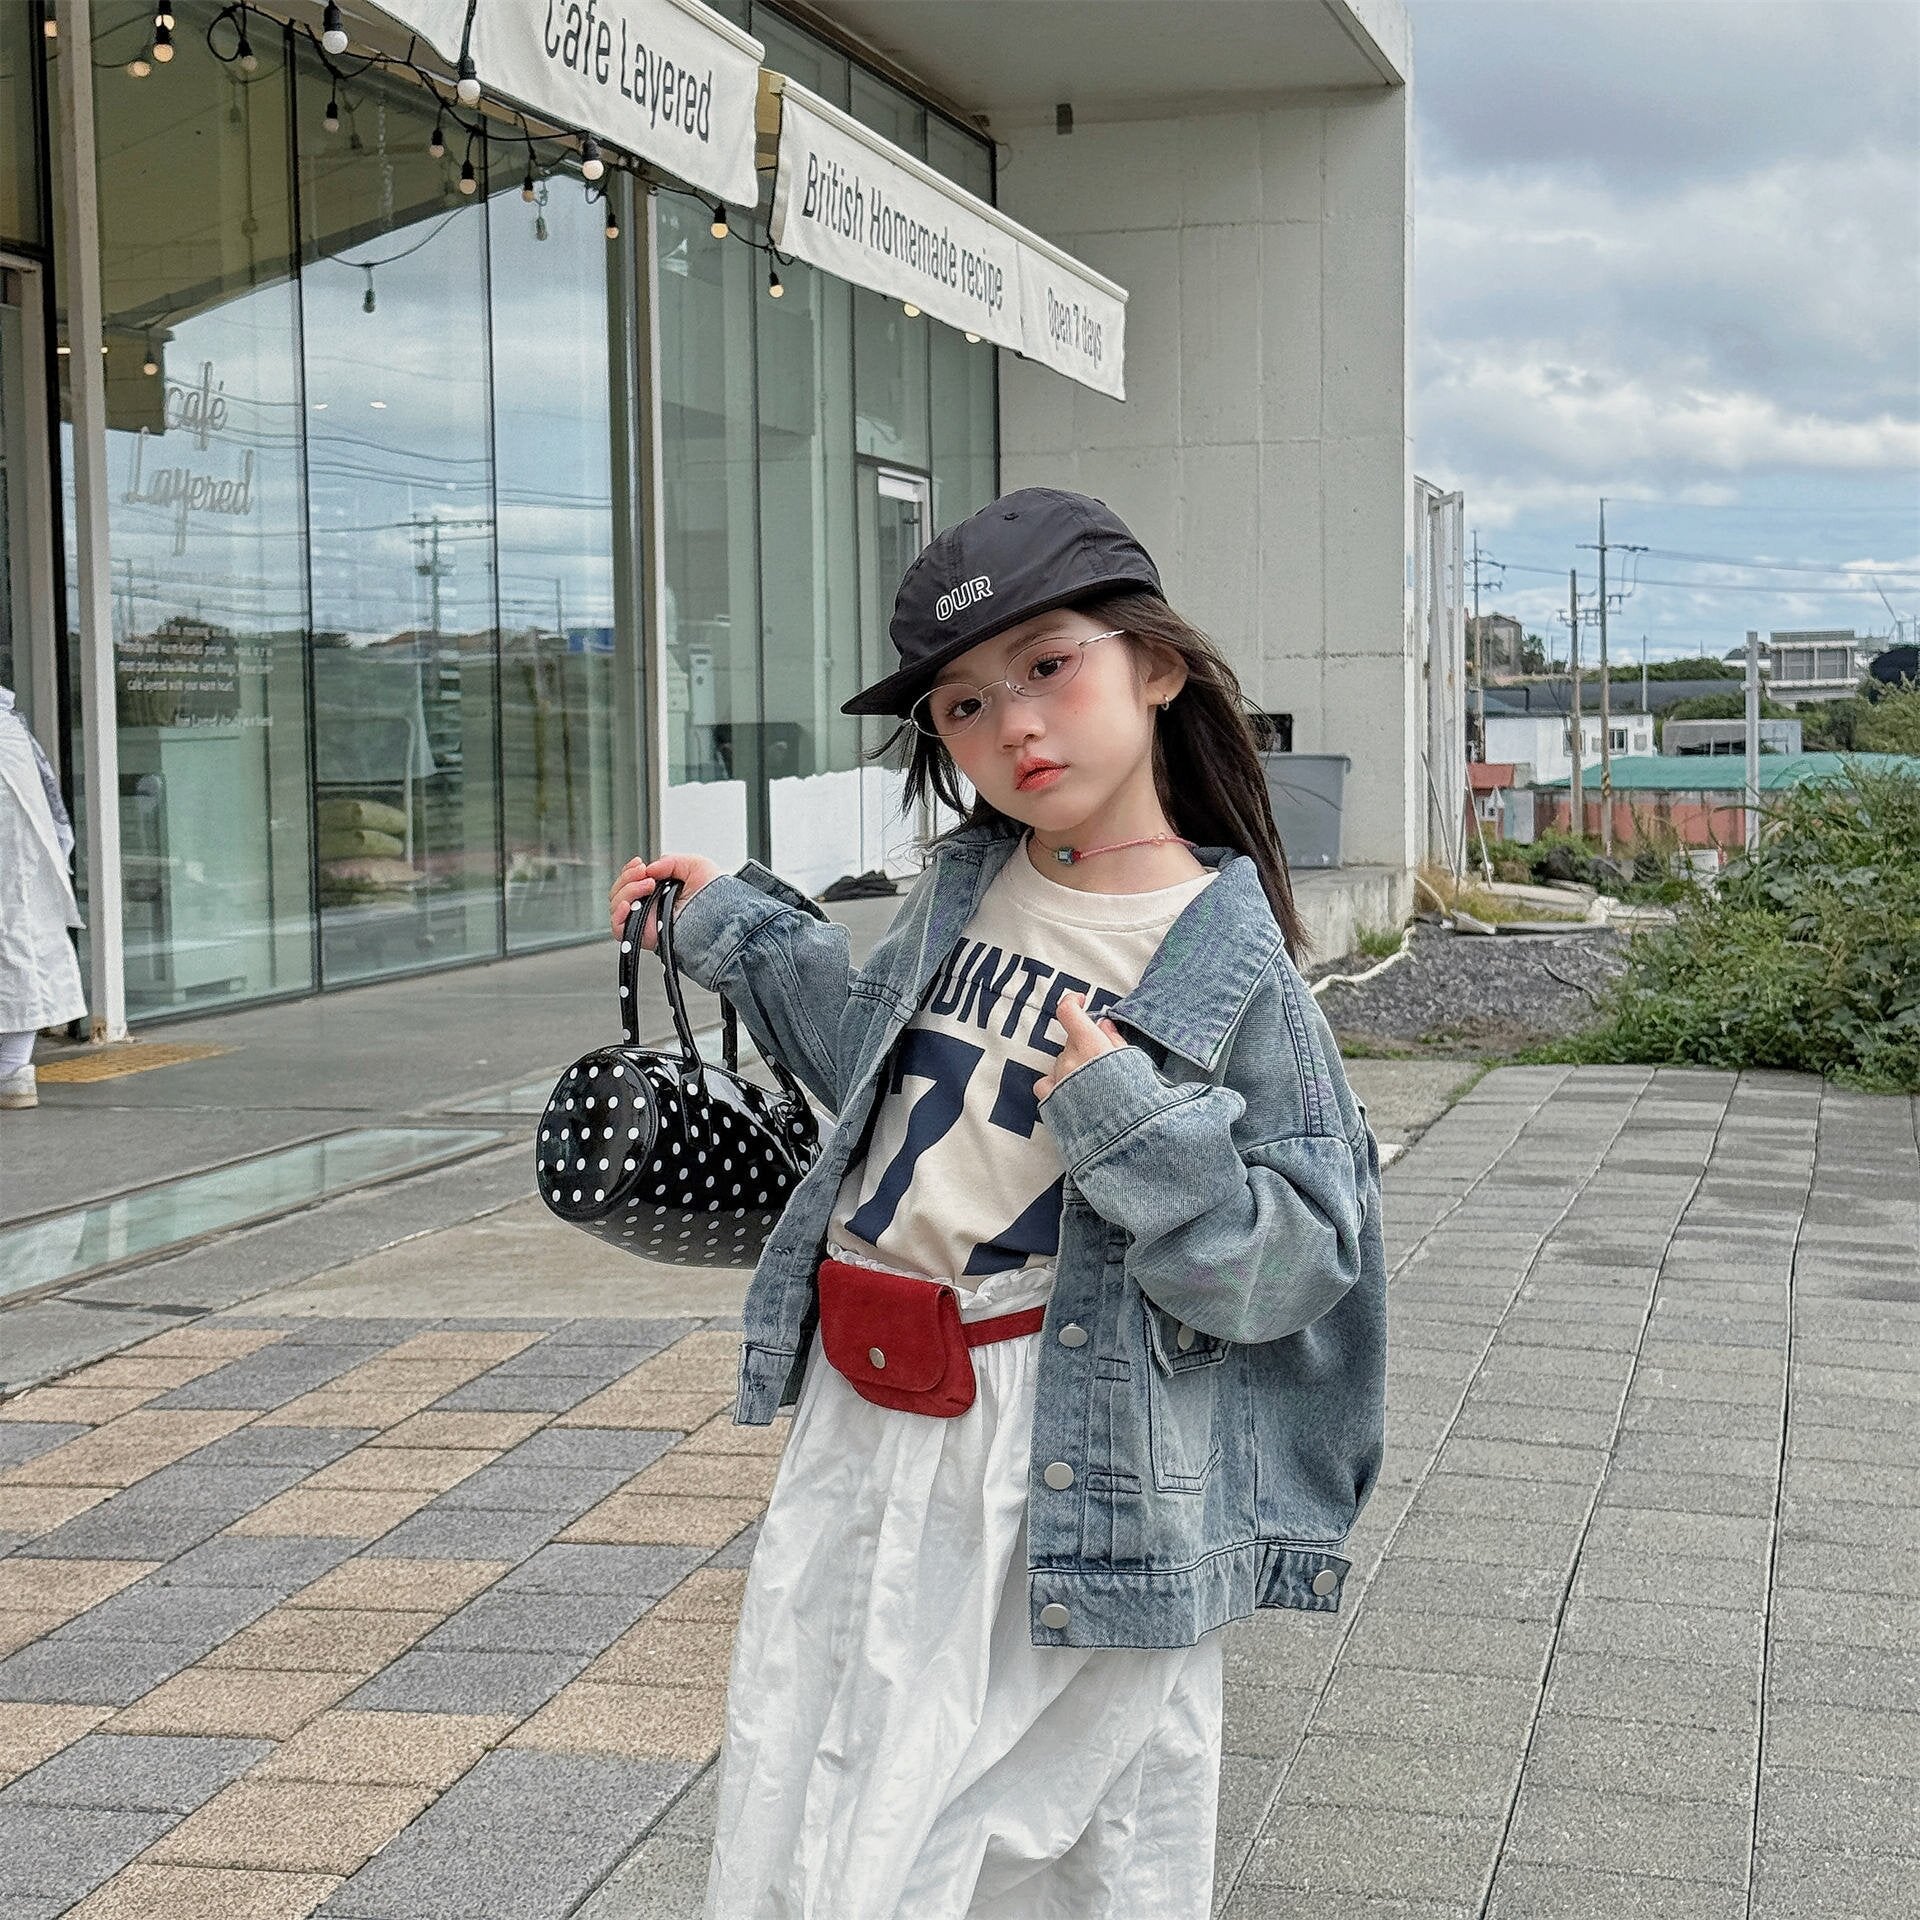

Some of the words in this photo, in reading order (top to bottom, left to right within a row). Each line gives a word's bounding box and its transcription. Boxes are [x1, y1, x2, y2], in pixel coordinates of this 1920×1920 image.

[544, 0, 612, 85] Cafe
[620, 17, 712, 143] Layered
[801, 151, 864, 243] British
[870, 186, 957, 289] Homemade
[961, 247, 1003, 317] recipe
[1047, 286, 1073, 352] Open
[1073, 303, 1080, 349] 7
[1082, 304, 1102, 369] days
[164, 361, 229, 450] café
[126, 426, 253, 556] Layered
[935, 575, 994, 621] OUR
[918, 936, 1125, 1058] UNTE
